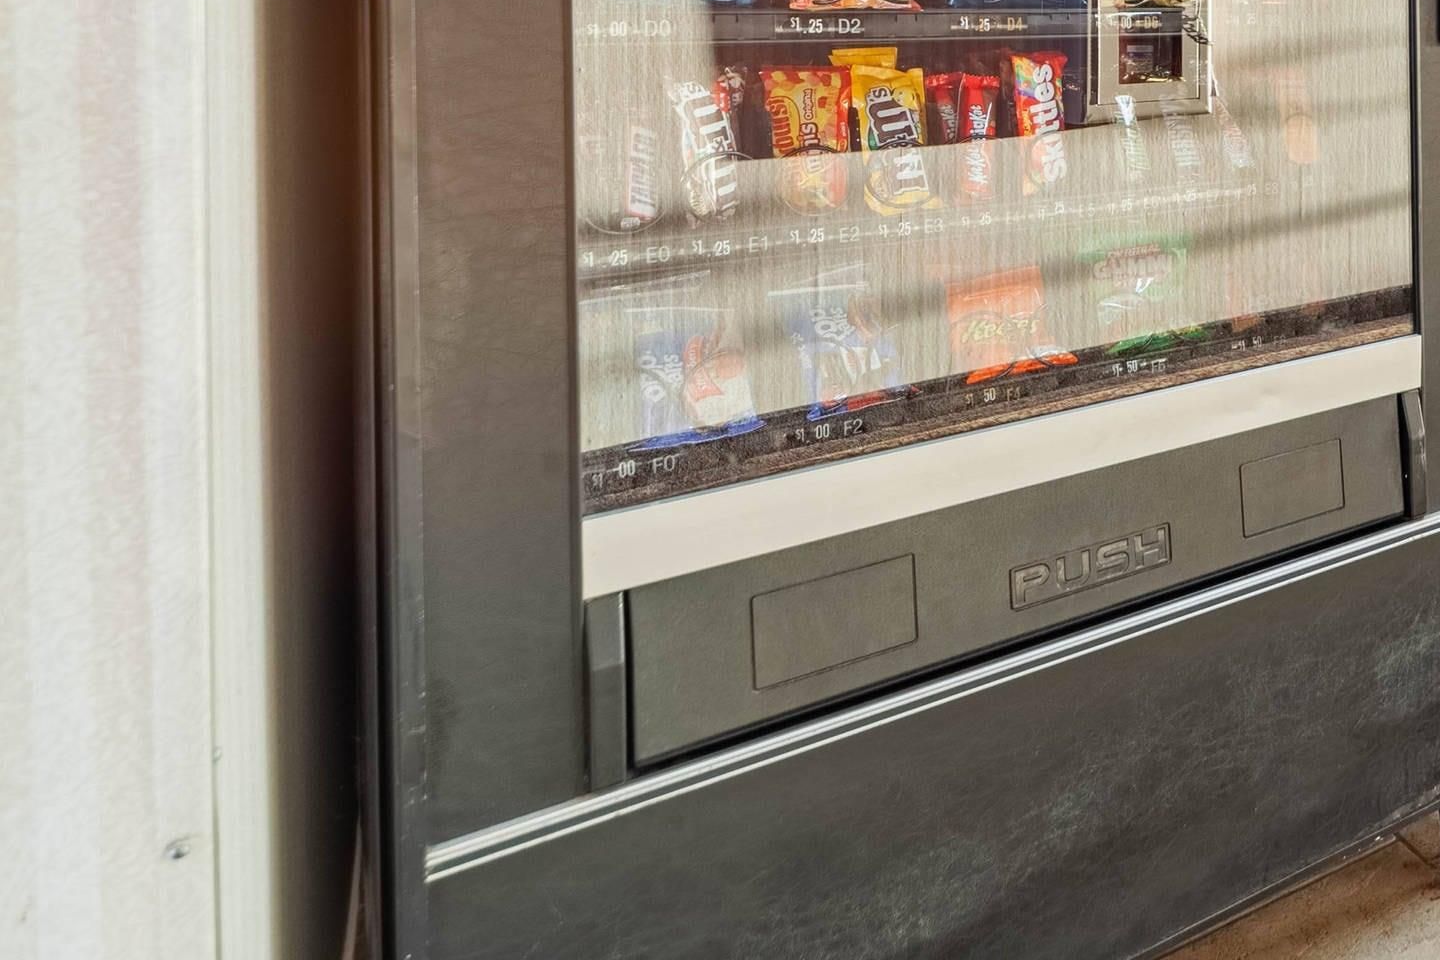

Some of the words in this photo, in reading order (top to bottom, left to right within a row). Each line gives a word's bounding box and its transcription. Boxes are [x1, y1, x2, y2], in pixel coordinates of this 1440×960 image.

[643, 19, 672, 38] D0
[789, 17, 824, 35] $1.25
[838, 19, 861, 34] D2
[1007, 17, 1023, 31] D4
[1031, 63, 1067, 183] Skittles
[923, 217, 944, 234] E3
[839, 226, 860, 244] E2
[748, 237, 769, 253] E1
[645, 246, 671, 265] E0
[843, 419, 864, 436] F2
[652, 454, 676, 474] F0
[1014, 526, 1168, 608] PUSH
